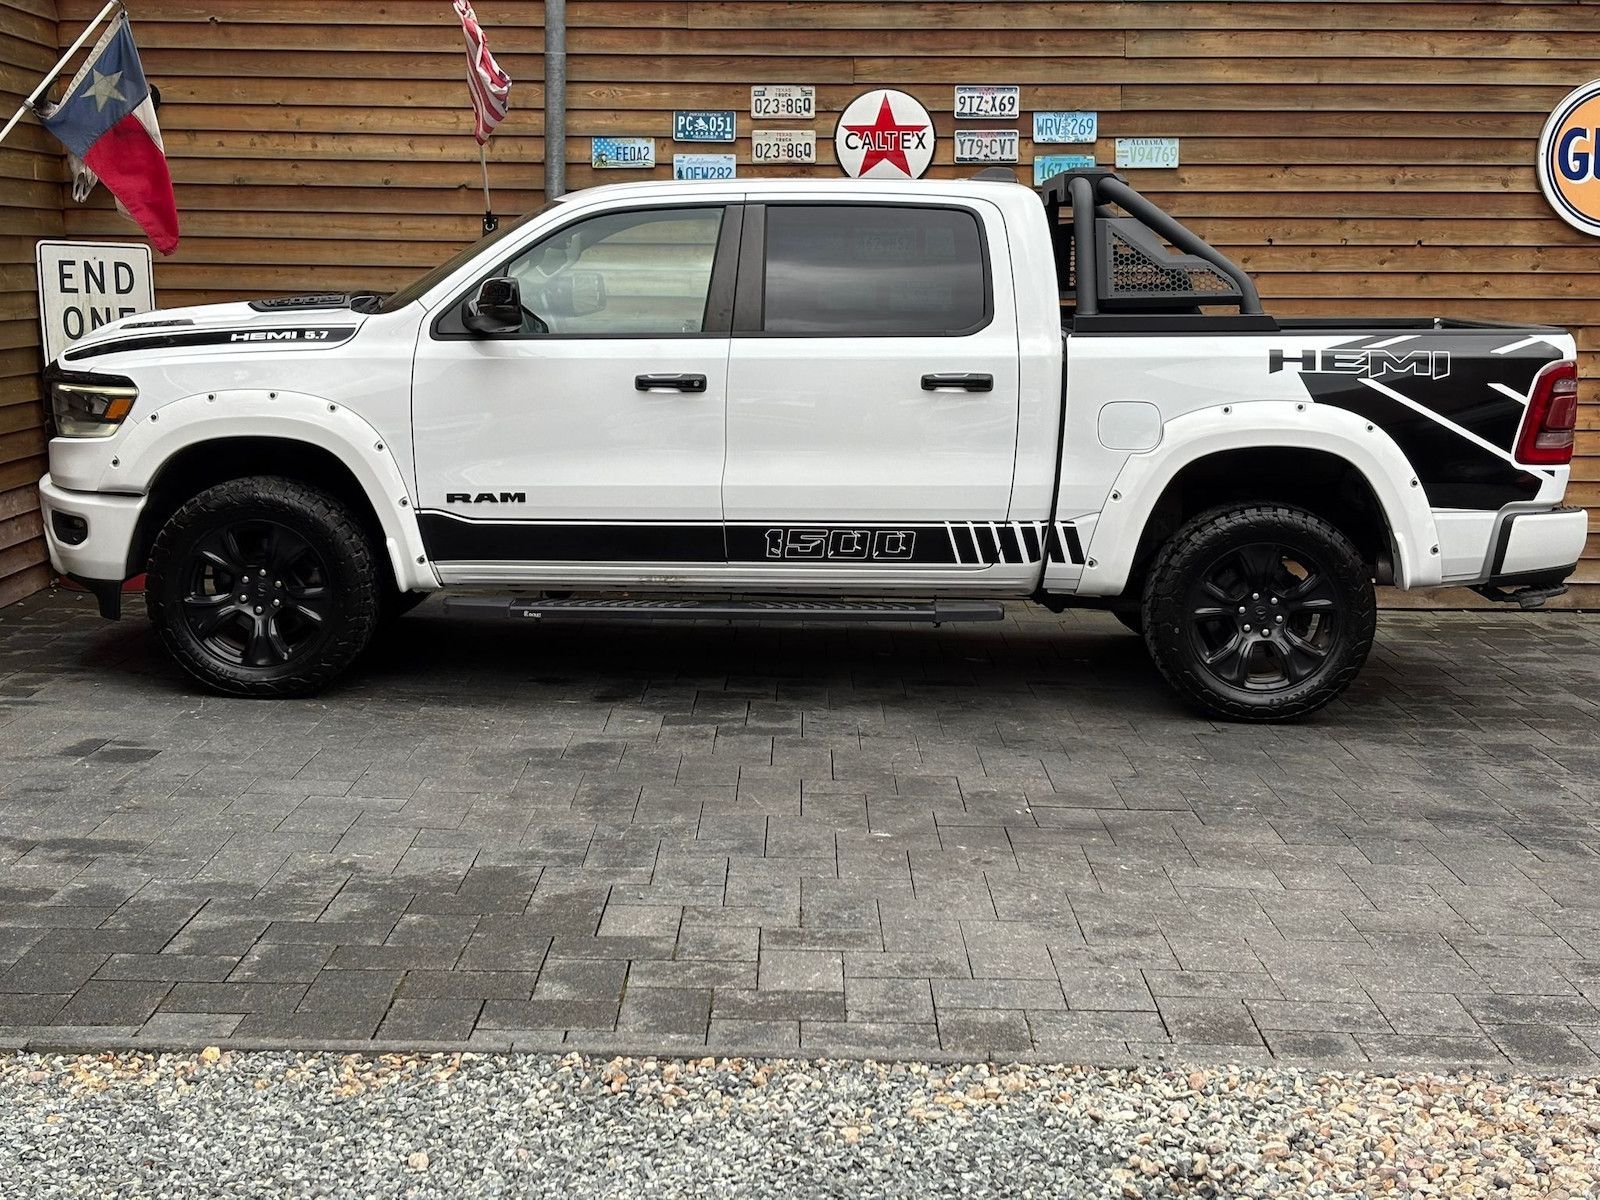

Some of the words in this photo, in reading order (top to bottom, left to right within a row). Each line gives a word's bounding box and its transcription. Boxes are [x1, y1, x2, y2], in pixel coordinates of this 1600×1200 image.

[754, 98, 780, 114] 023
[786, 98, 811, 114] 8GQ
[958, 95, 984, 112] 9TZ
[990, 95, 1016, 112] X69
[678, 116, 693, 131] PC
[709, 116, 732, 132] 051
[1036, 118, 1062, 136] WRV
[1071, 118, 1094, 136] 269
[845, 132, 927, 150] CALTEX
[958, 139, 984, 155] Y79
[990, 139, 1016, 155] CVT
[755, 143, 780, 159] 023
[787, 142, 812, 158] 8GQ
[58, 260, 135, 295] END
[230, 331, 298, 342] HEMI
[304, 330, 330, 340] 5.7
[1268, 348, 1451, 380] HEMI
[446, 492, 526, 504] RAM
[764, 528, 917, 560] 1500
